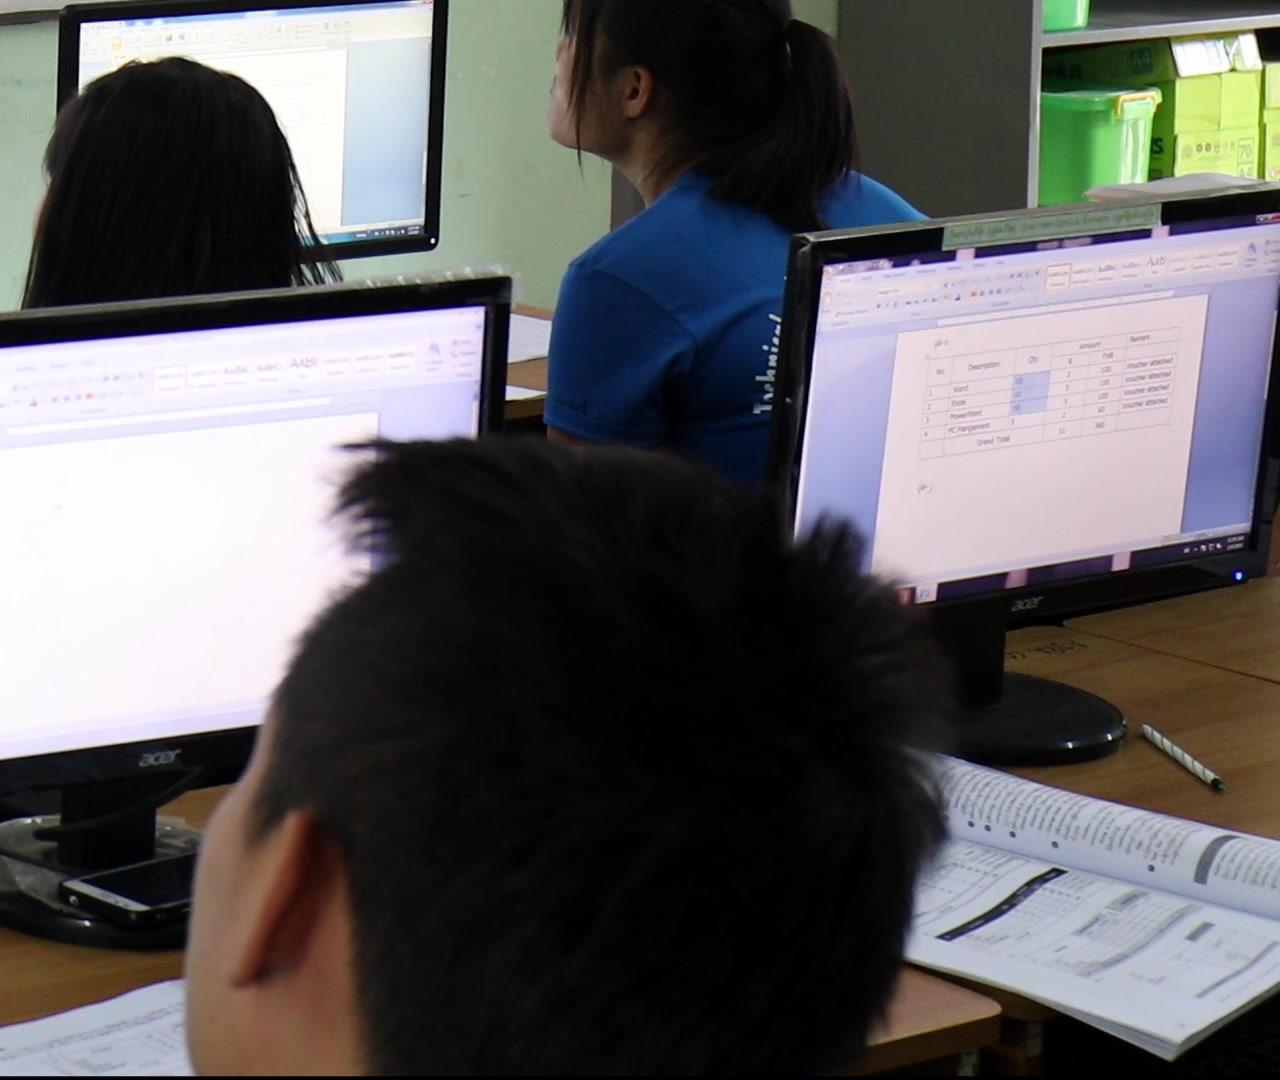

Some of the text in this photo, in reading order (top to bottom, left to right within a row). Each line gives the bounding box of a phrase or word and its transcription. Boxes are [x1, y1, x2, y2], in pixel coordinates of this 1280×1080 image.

[1131, 49, 1152, 67] A4
[1239, 144, 1253, 158] 70
[138, 749, 182, 768] acer
